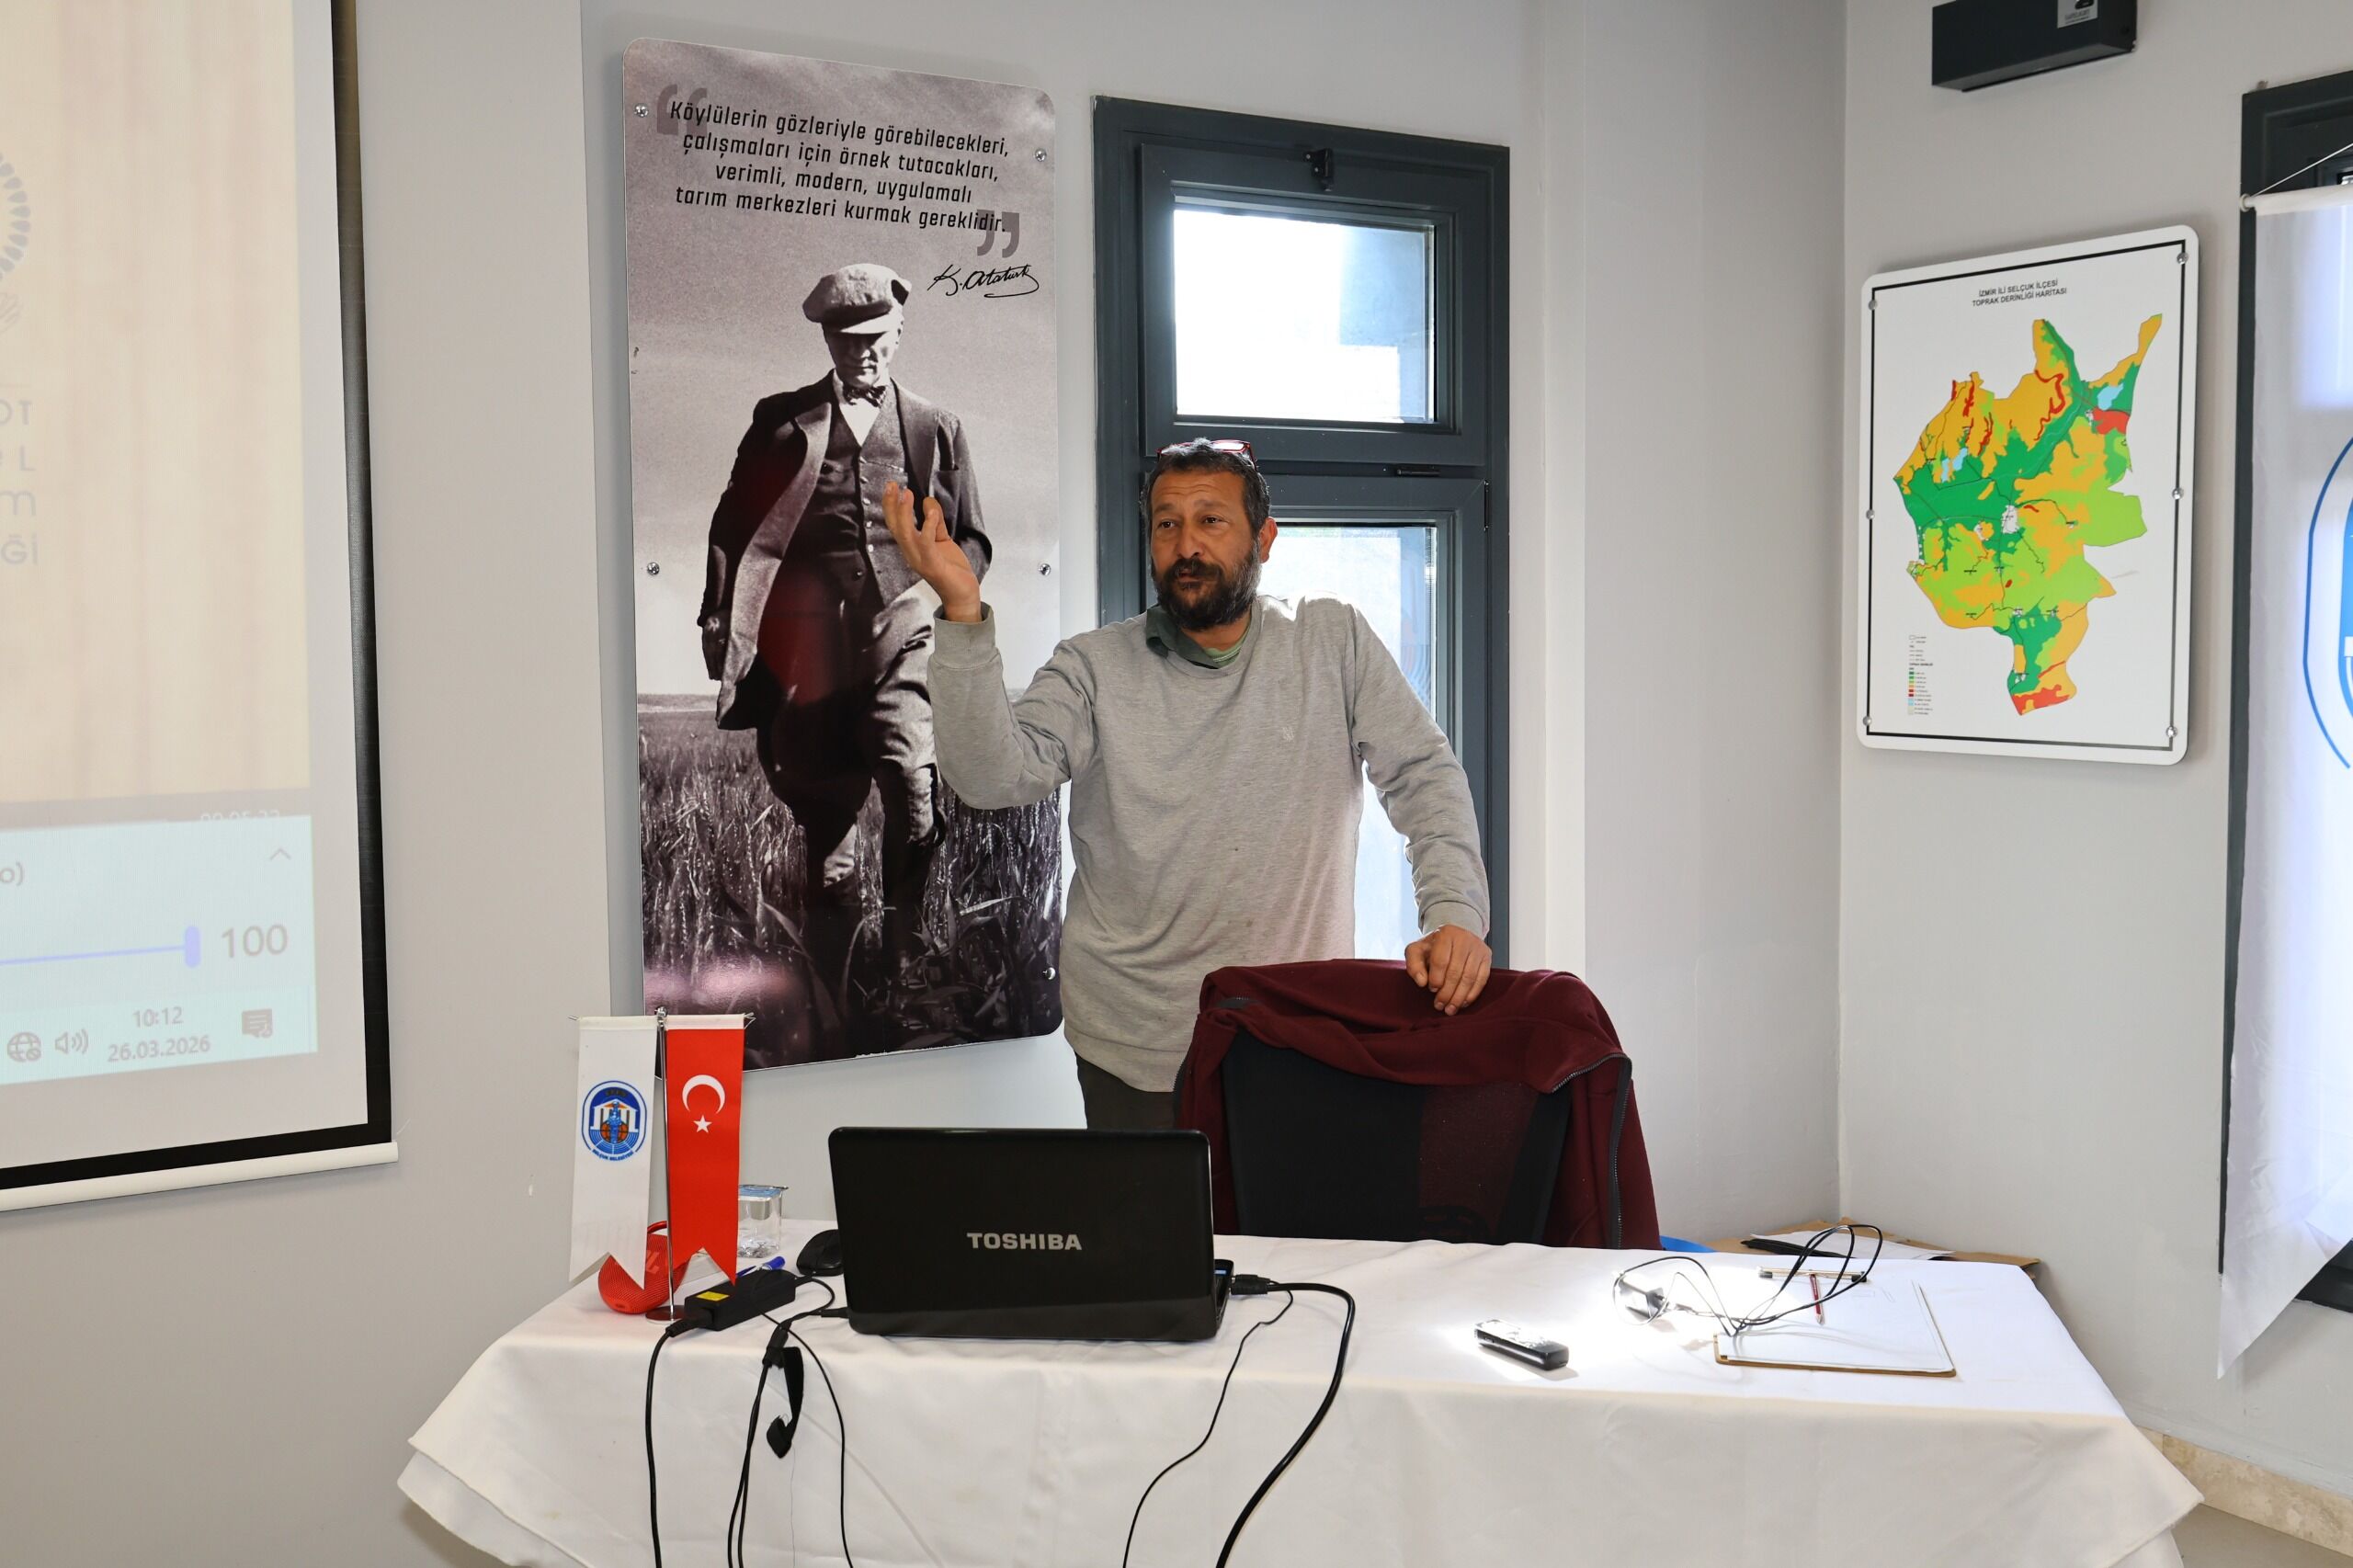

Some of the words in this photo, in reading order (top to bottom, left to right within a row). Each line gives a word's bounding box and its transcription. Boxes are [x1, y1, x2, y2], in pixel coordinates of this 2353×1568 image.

[670, 101, 767, 129] Köylülerin
[777, 115, 866, 142] gözleriyle
[875, 126, 1008, 157] görebilecekleri,
[684, 132, 790, 159] çalışmaları
[799, 142, 831, 167] için
[840, 147, 891, 169] örnek
[899, 155, 998, 182] tutacakları,
[717, 165, 786, 187] verimli,
[796, 173, 868, 196] modern,
[878, 182, 972, 203] uygulamalı
[676, 187, 727, 208] tarım
[736, 194, 836, 217] merkezleri
[845, 200, 911, 223] kurmak
[919, 211, 1006, 233] gereklidir.
[1972, 297, 1999, 307] TOPRAK
[2007, 283, 2035, 293] SELÇUK
[222, 925, 288, 959] 100
[132, 1006, 184, 1028] 10:12
[108, 1035, 210, 1062] 26.03.2026
[967, 1233, 1083, 1251] TOSHIBA
